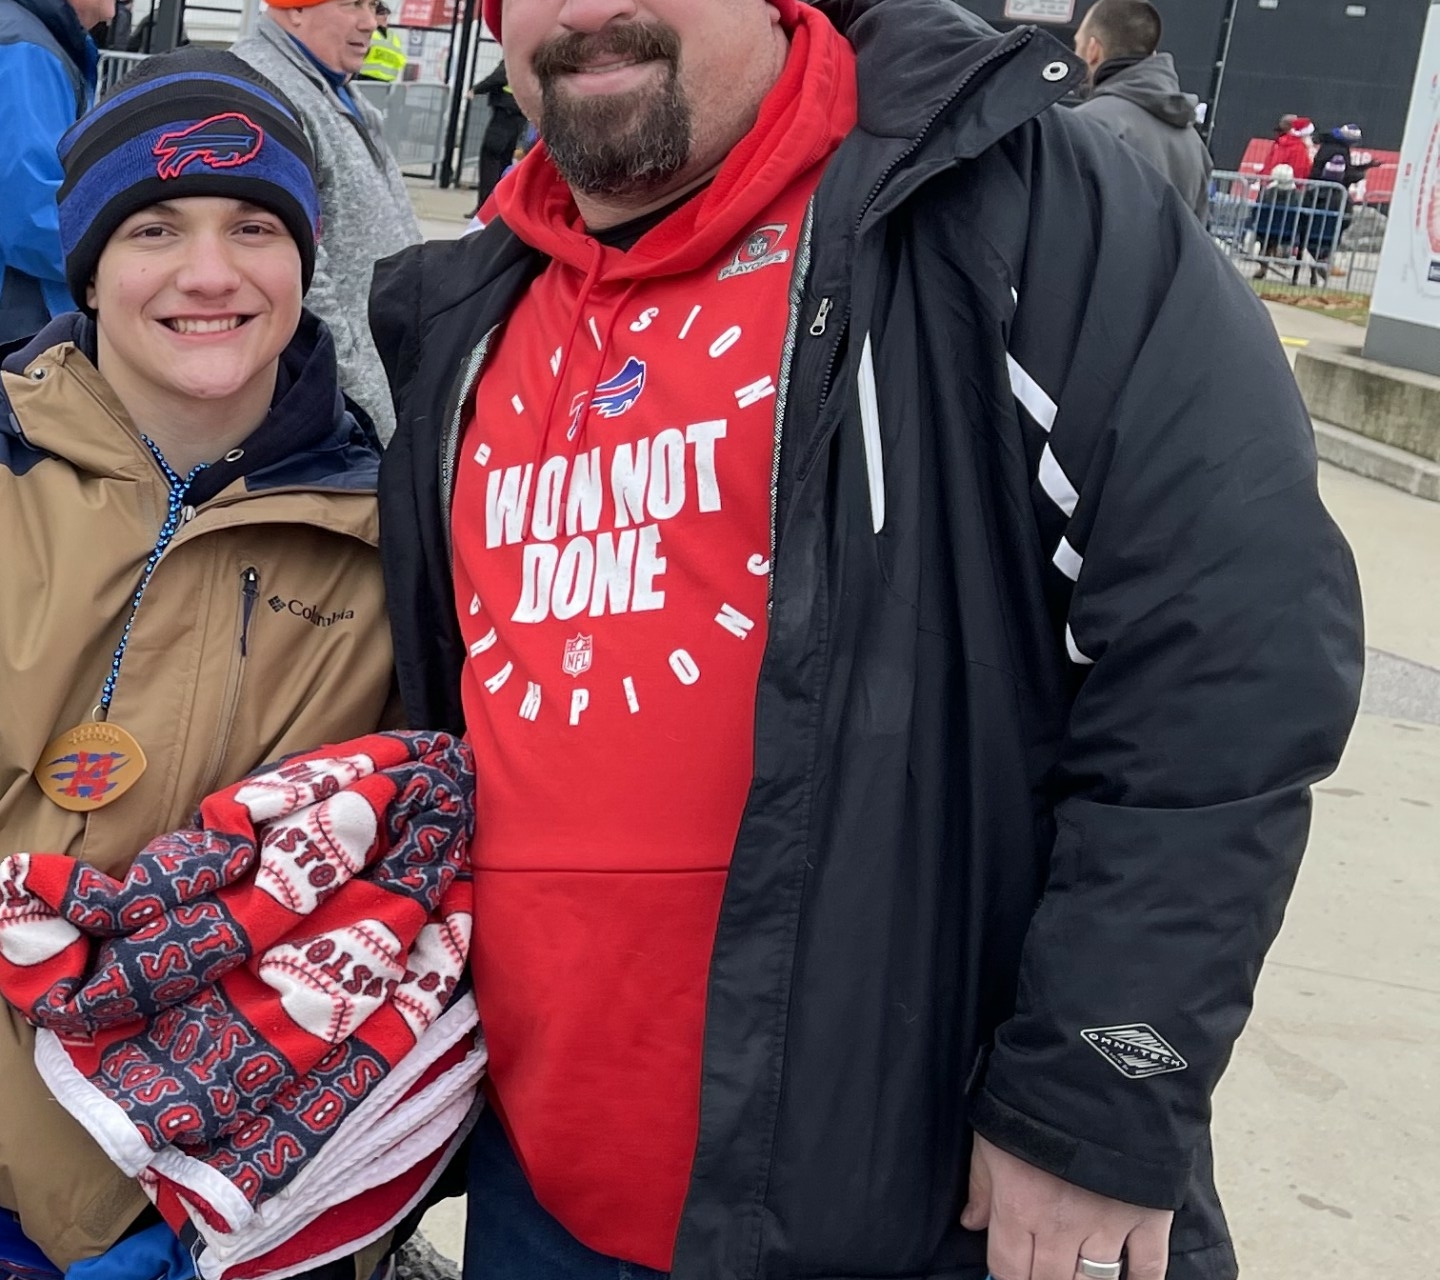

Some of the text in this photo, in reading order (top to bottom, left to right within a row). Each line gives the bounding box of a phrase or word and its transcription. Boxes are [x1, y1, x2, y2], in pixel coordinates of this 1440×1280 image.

[485, 419, 728, 549] WON NOT
[512, 523, 668, 624] DONE
[566, 651, 588, 670] NFL
